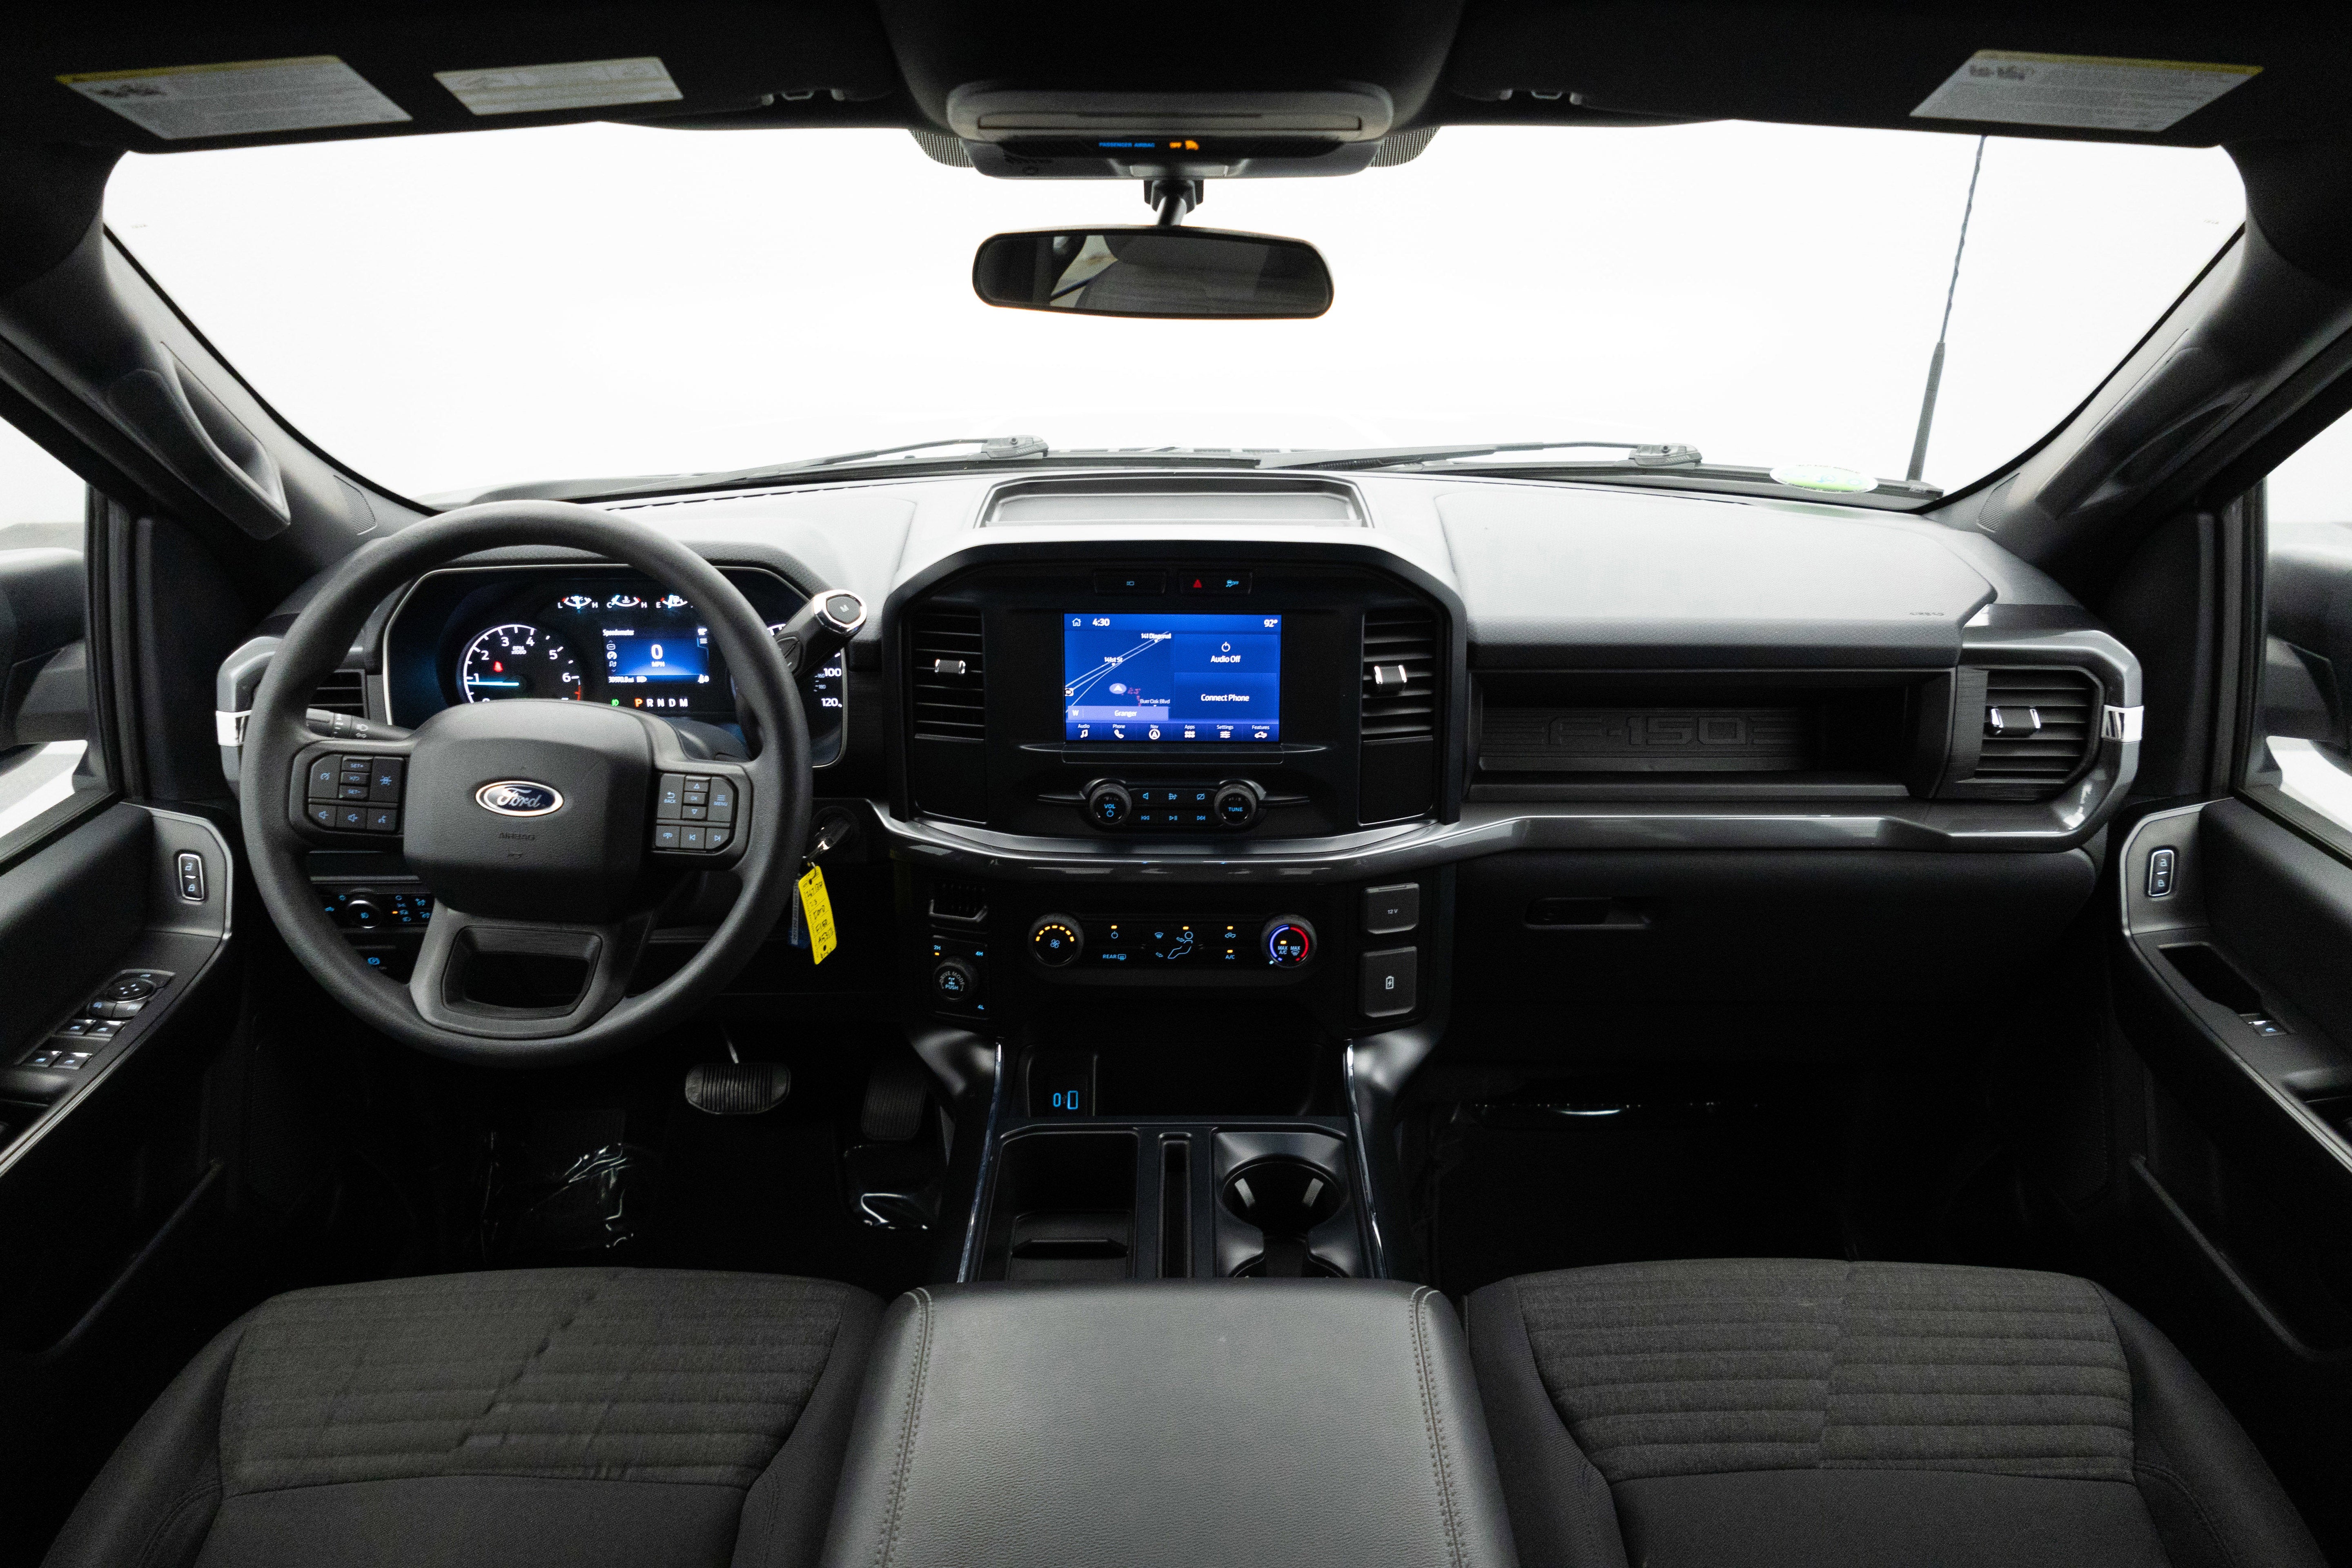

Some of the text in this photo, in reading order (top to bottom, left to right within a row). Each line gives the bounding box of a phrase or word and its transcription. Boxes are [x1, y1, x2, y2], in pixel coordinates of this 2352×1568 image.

[1092, 618, 1110, 626] 4:30
[1264, 619, 1278, 628] 92°
[501, 637, 510, 646] 3
[526, 637, 535, 646] 4
[481, 650, 489, 660] 2
[549, 650, 558, 659] 5
[651, 644, 663, 659] 0
[823, 668, 842, 677] 100
[474, 673, 479, 682] 1
[562, 673, 571, 682] 6
[635, 698, 688, 707] P R N D M
[821, 698, 838, 706] 120
[497, 787, 542, 808] Ford
[952, 971, 965, 985] MODE
